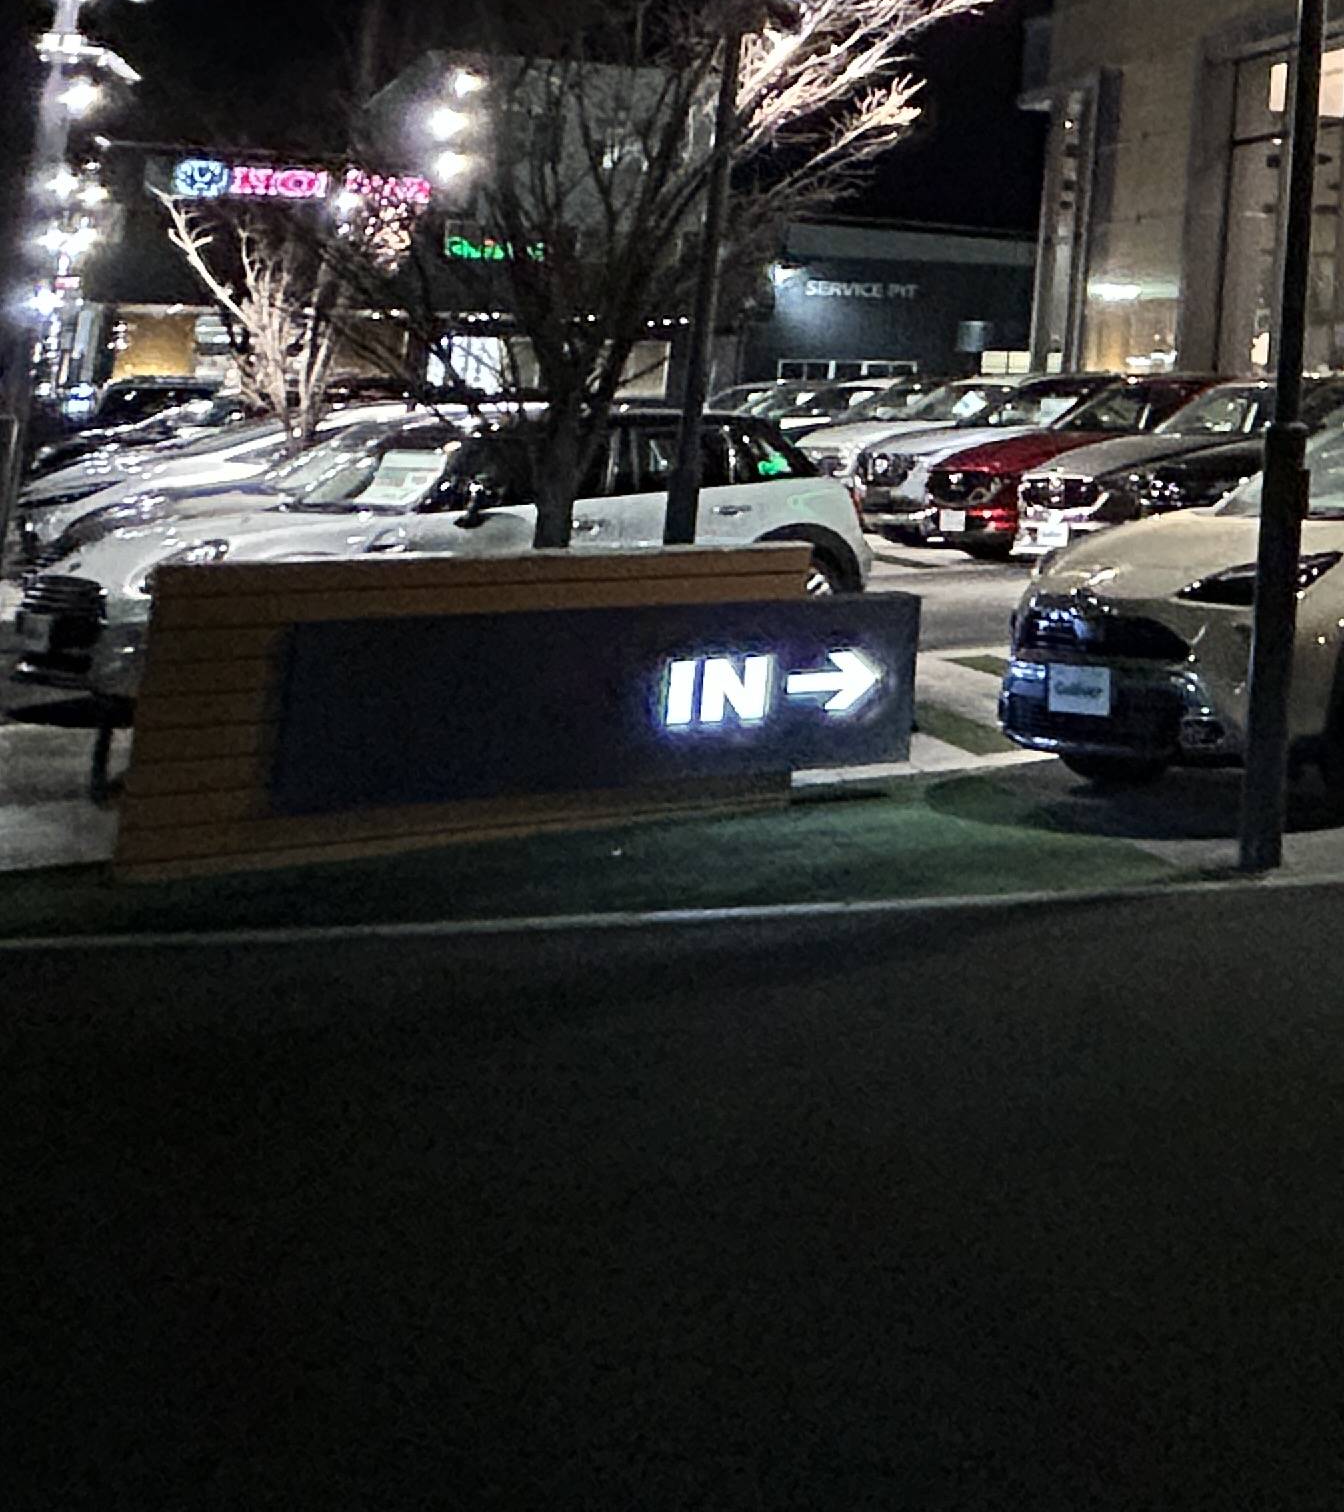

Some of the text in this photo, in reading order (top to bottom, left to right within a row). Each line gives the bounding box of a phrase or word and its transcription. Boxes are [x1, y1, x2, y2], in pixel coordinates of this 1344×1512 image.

[805, 280, 919, 298] SERVICE PIT
[665, 655, 770, 725] IN
